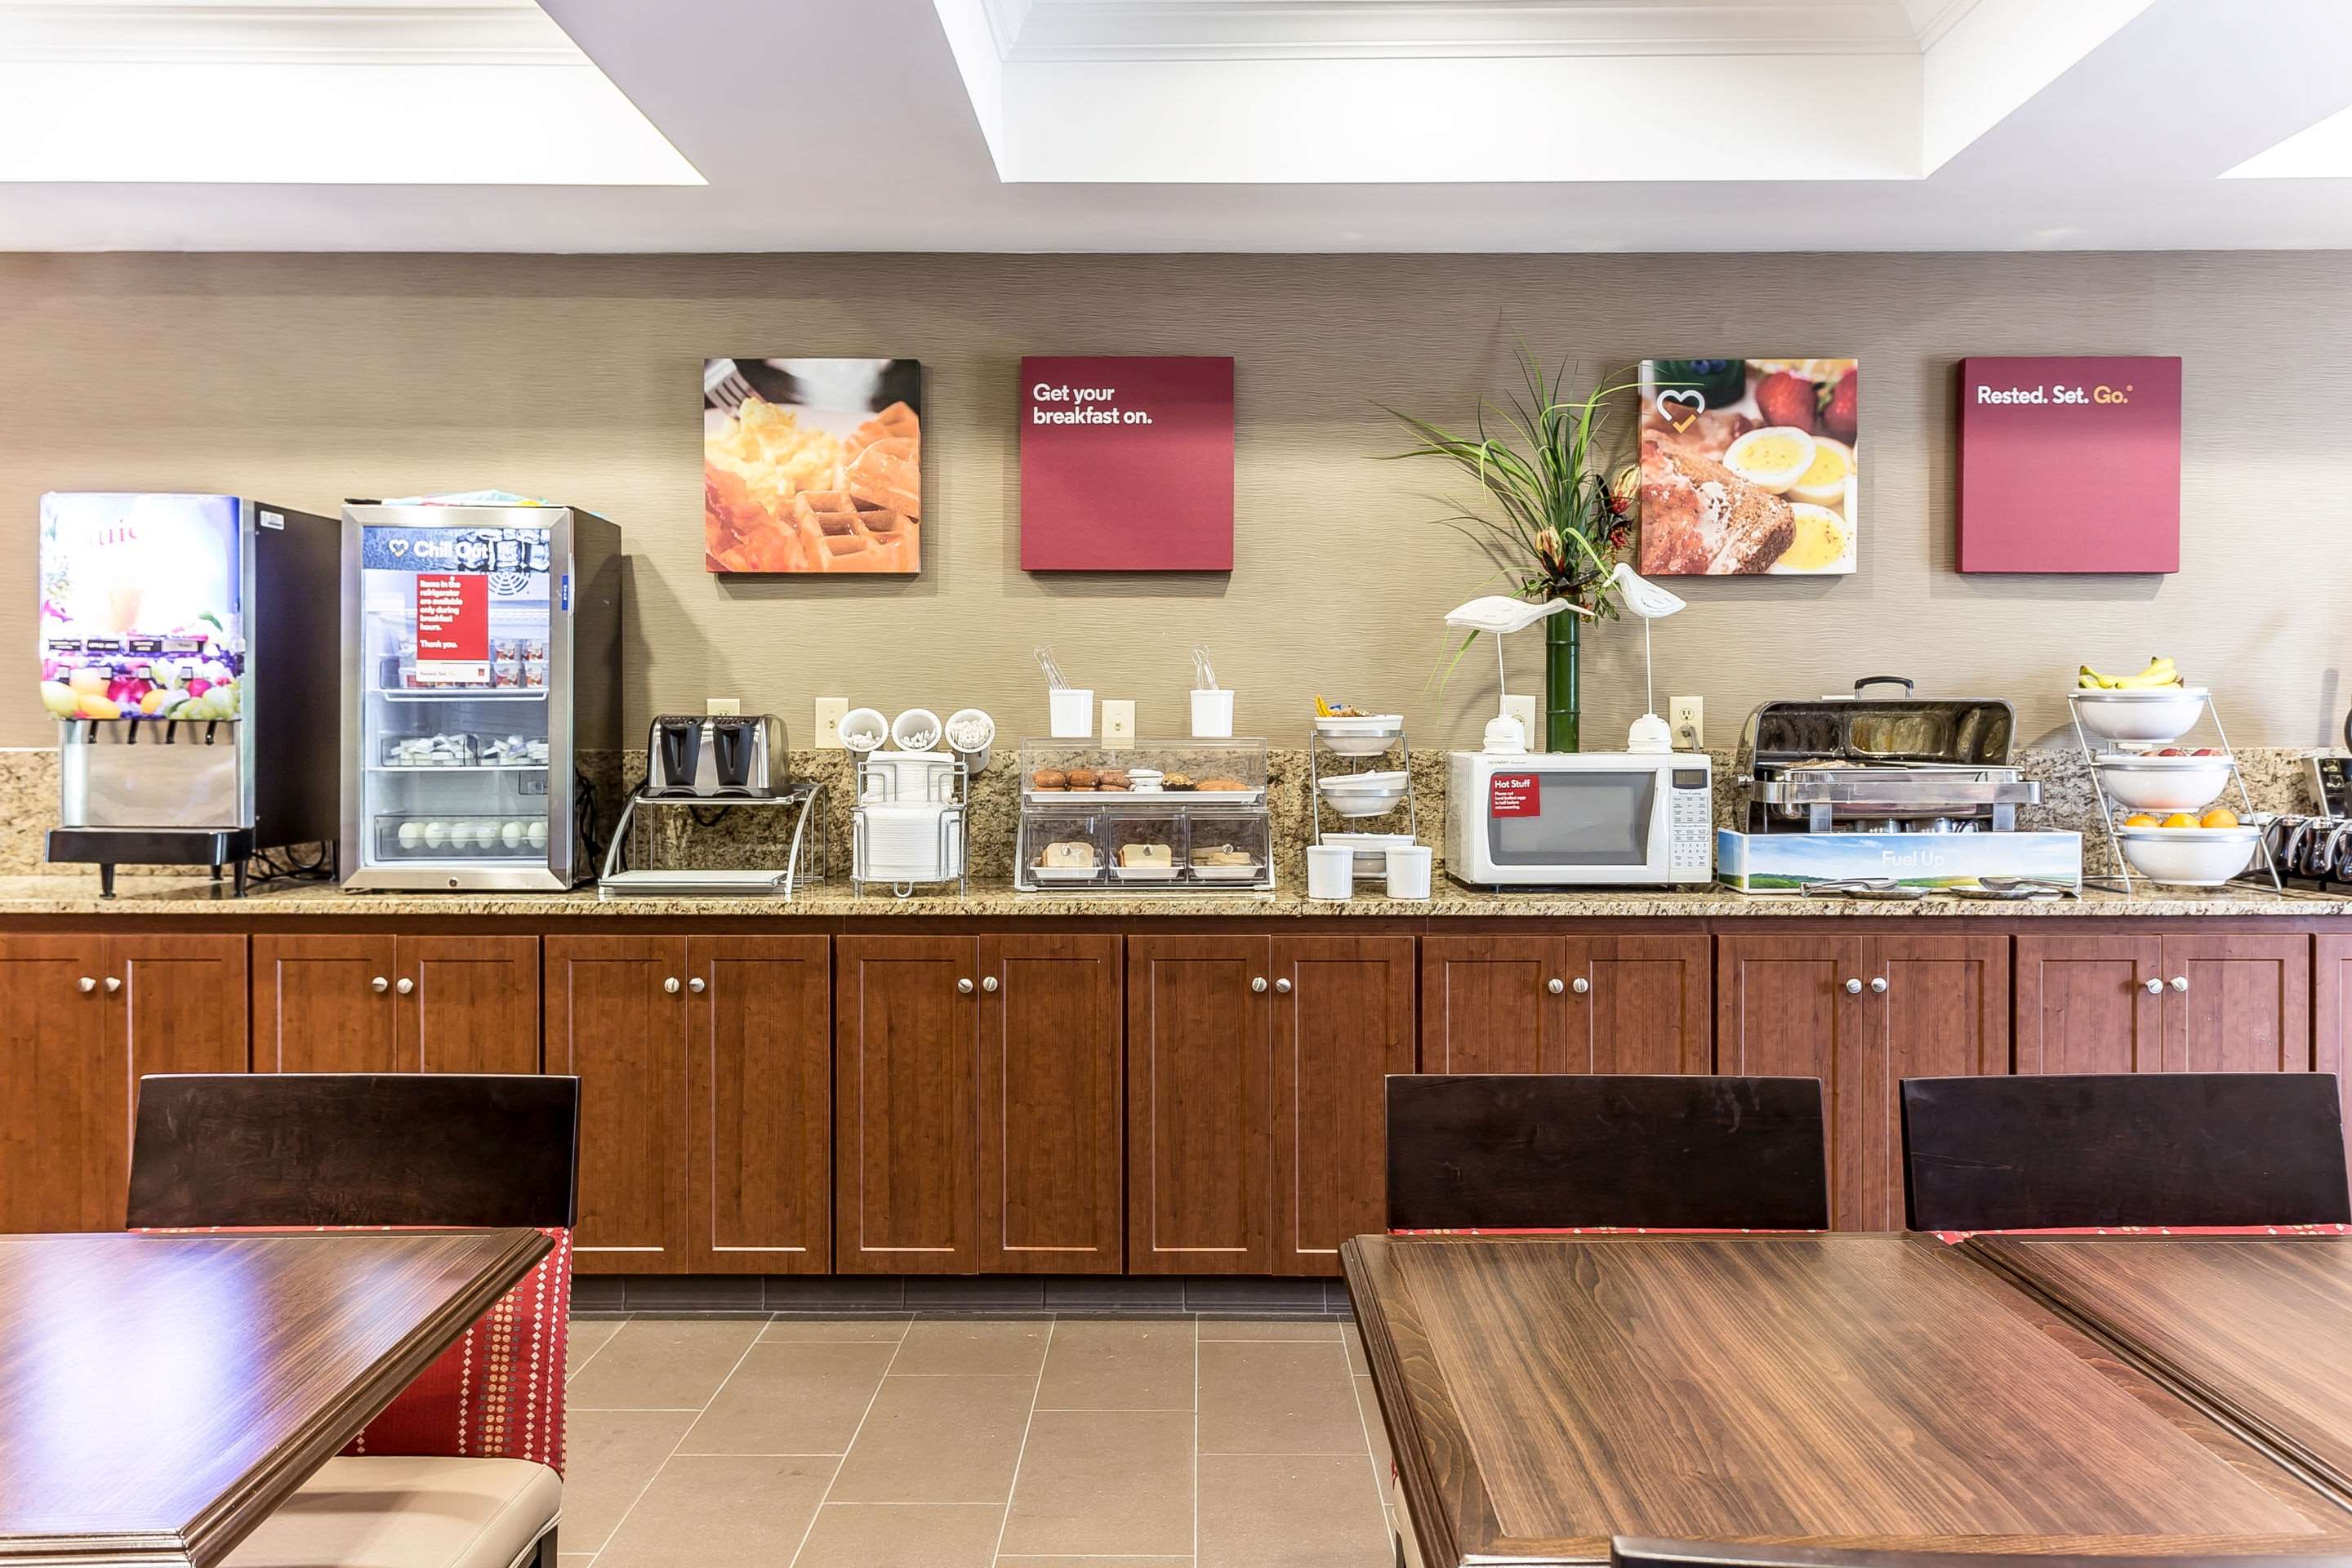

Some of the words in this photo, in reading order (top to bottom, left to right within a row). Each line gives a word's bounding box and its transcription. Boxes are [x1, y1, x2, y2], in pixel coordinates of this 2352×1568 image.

[1033, 383, 1070, 402] Get
[1073, 388, 1115, 404] your
[1977, 385, 2048, 404] Rested.
[2052, 385, 2089, 404] Set.
[1033, 407, 1120, 424] breakfast
[1123, 411, 1153, 424] on.
[413, 540, 452, 559] Chill
[456, 541, 489, 559] Out
[419, 639, 442, 648] Thank
[1494, 780, 1510, 788] Hot
[1511, 779, 1530, 788] Stuff
[1882, 850, 1917, 866] Fuel
[1922, 850, 1946, 869] Up
